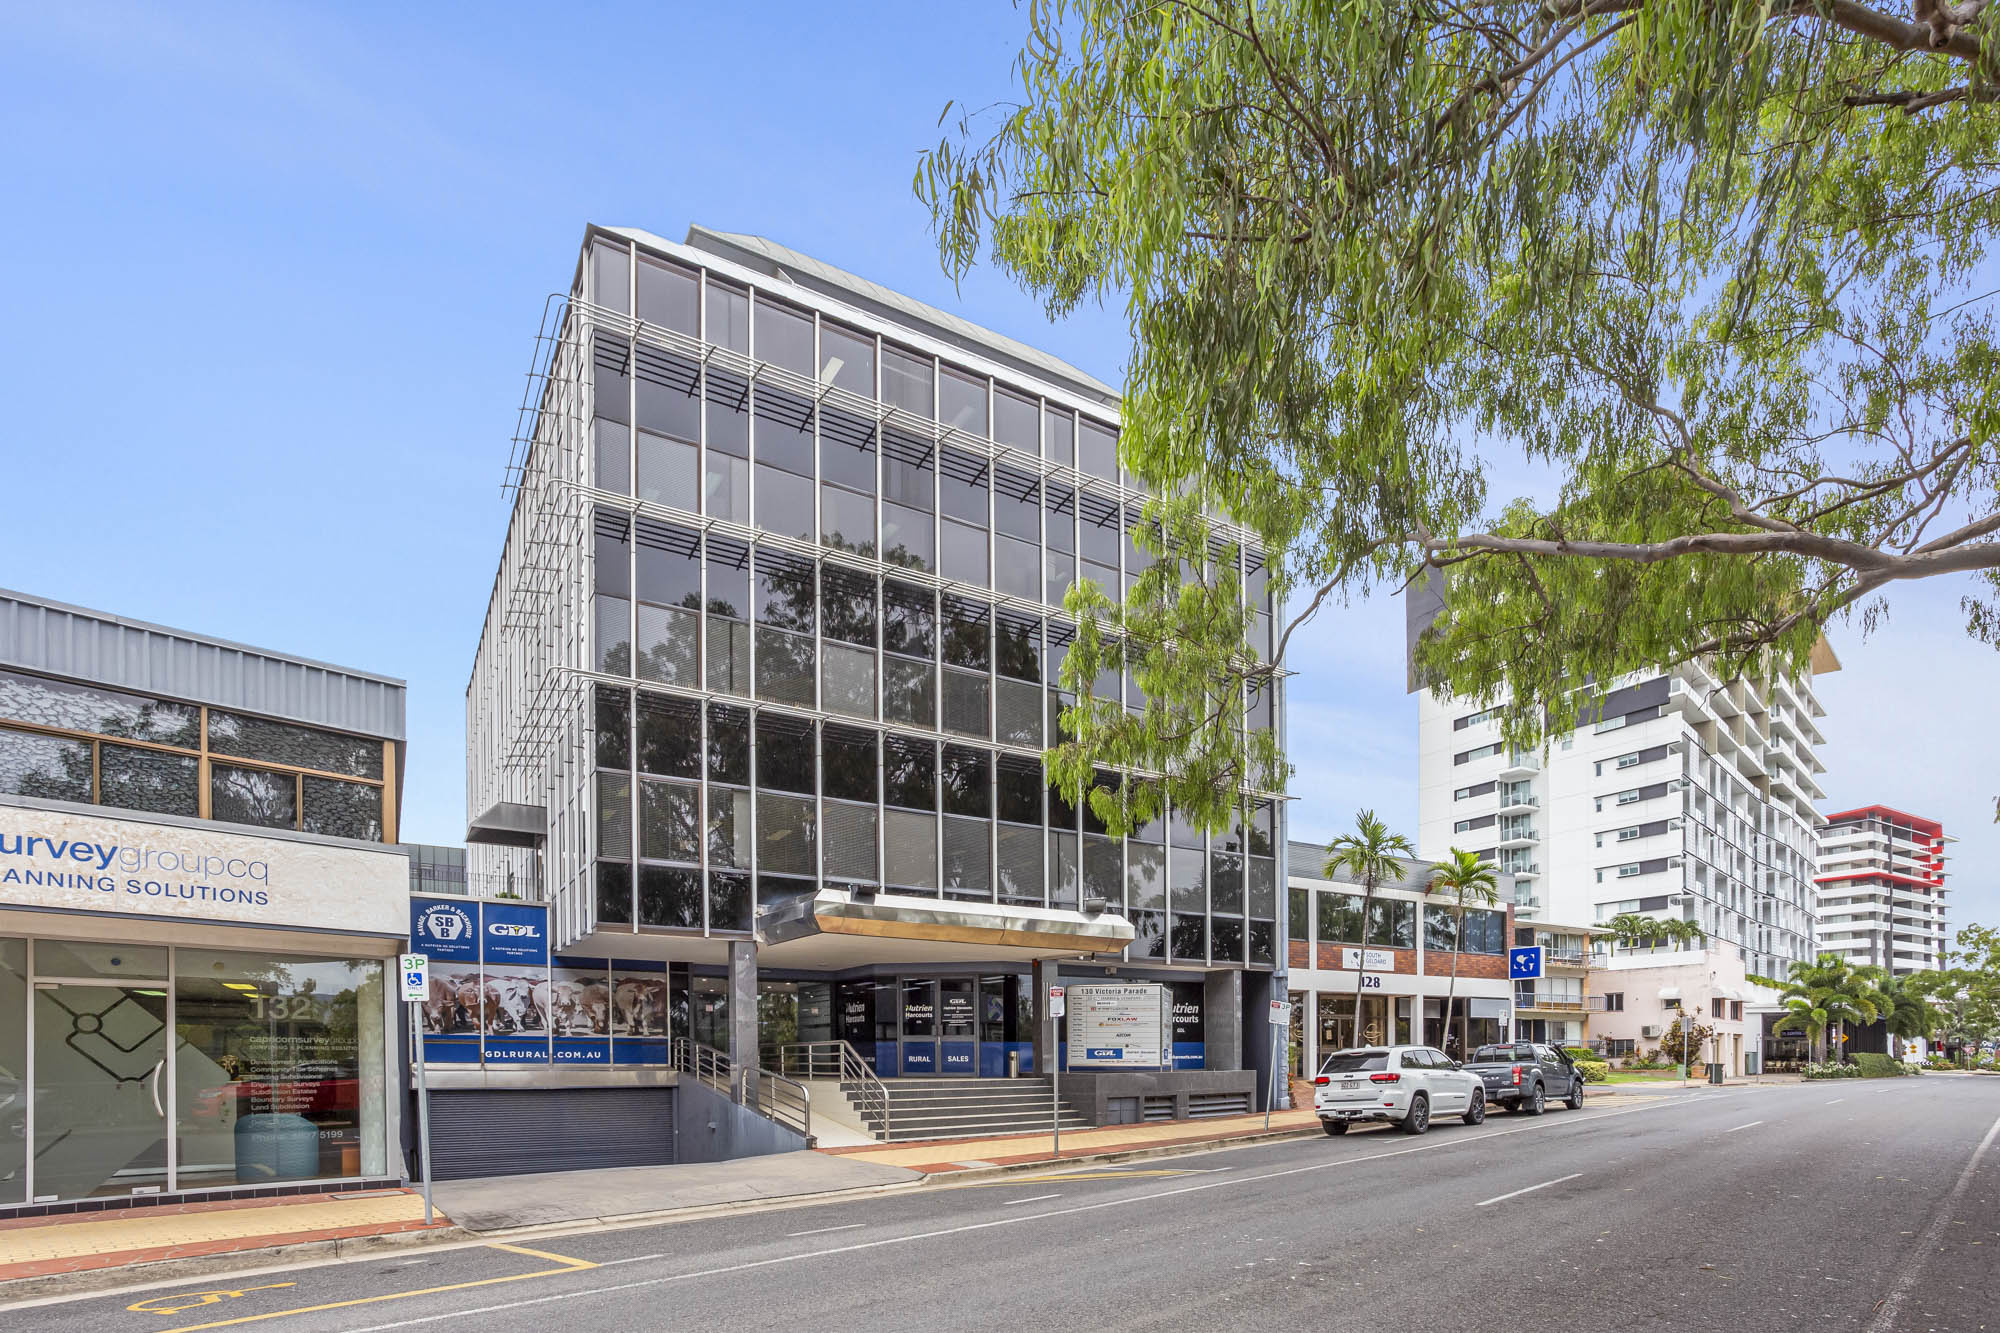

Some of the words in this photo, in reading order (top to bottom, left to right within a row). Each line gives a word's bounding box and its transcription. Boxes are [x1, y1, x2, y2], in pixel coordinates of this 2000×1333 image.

[127, 879, 268, 906] SOLUTIONS
[435, 916, 454, 927] SB
[441, 928, 450, 937] B
[488, 923, 540, 937] GDL
[404, 958, 425, 970] 3P
[1361, 976, 1380, 988] 128
[250, 995, 311, 1020] 132
[905, 1004, 933, 1012] Nutrien
[319, 1130, 344, 1139] 5199
